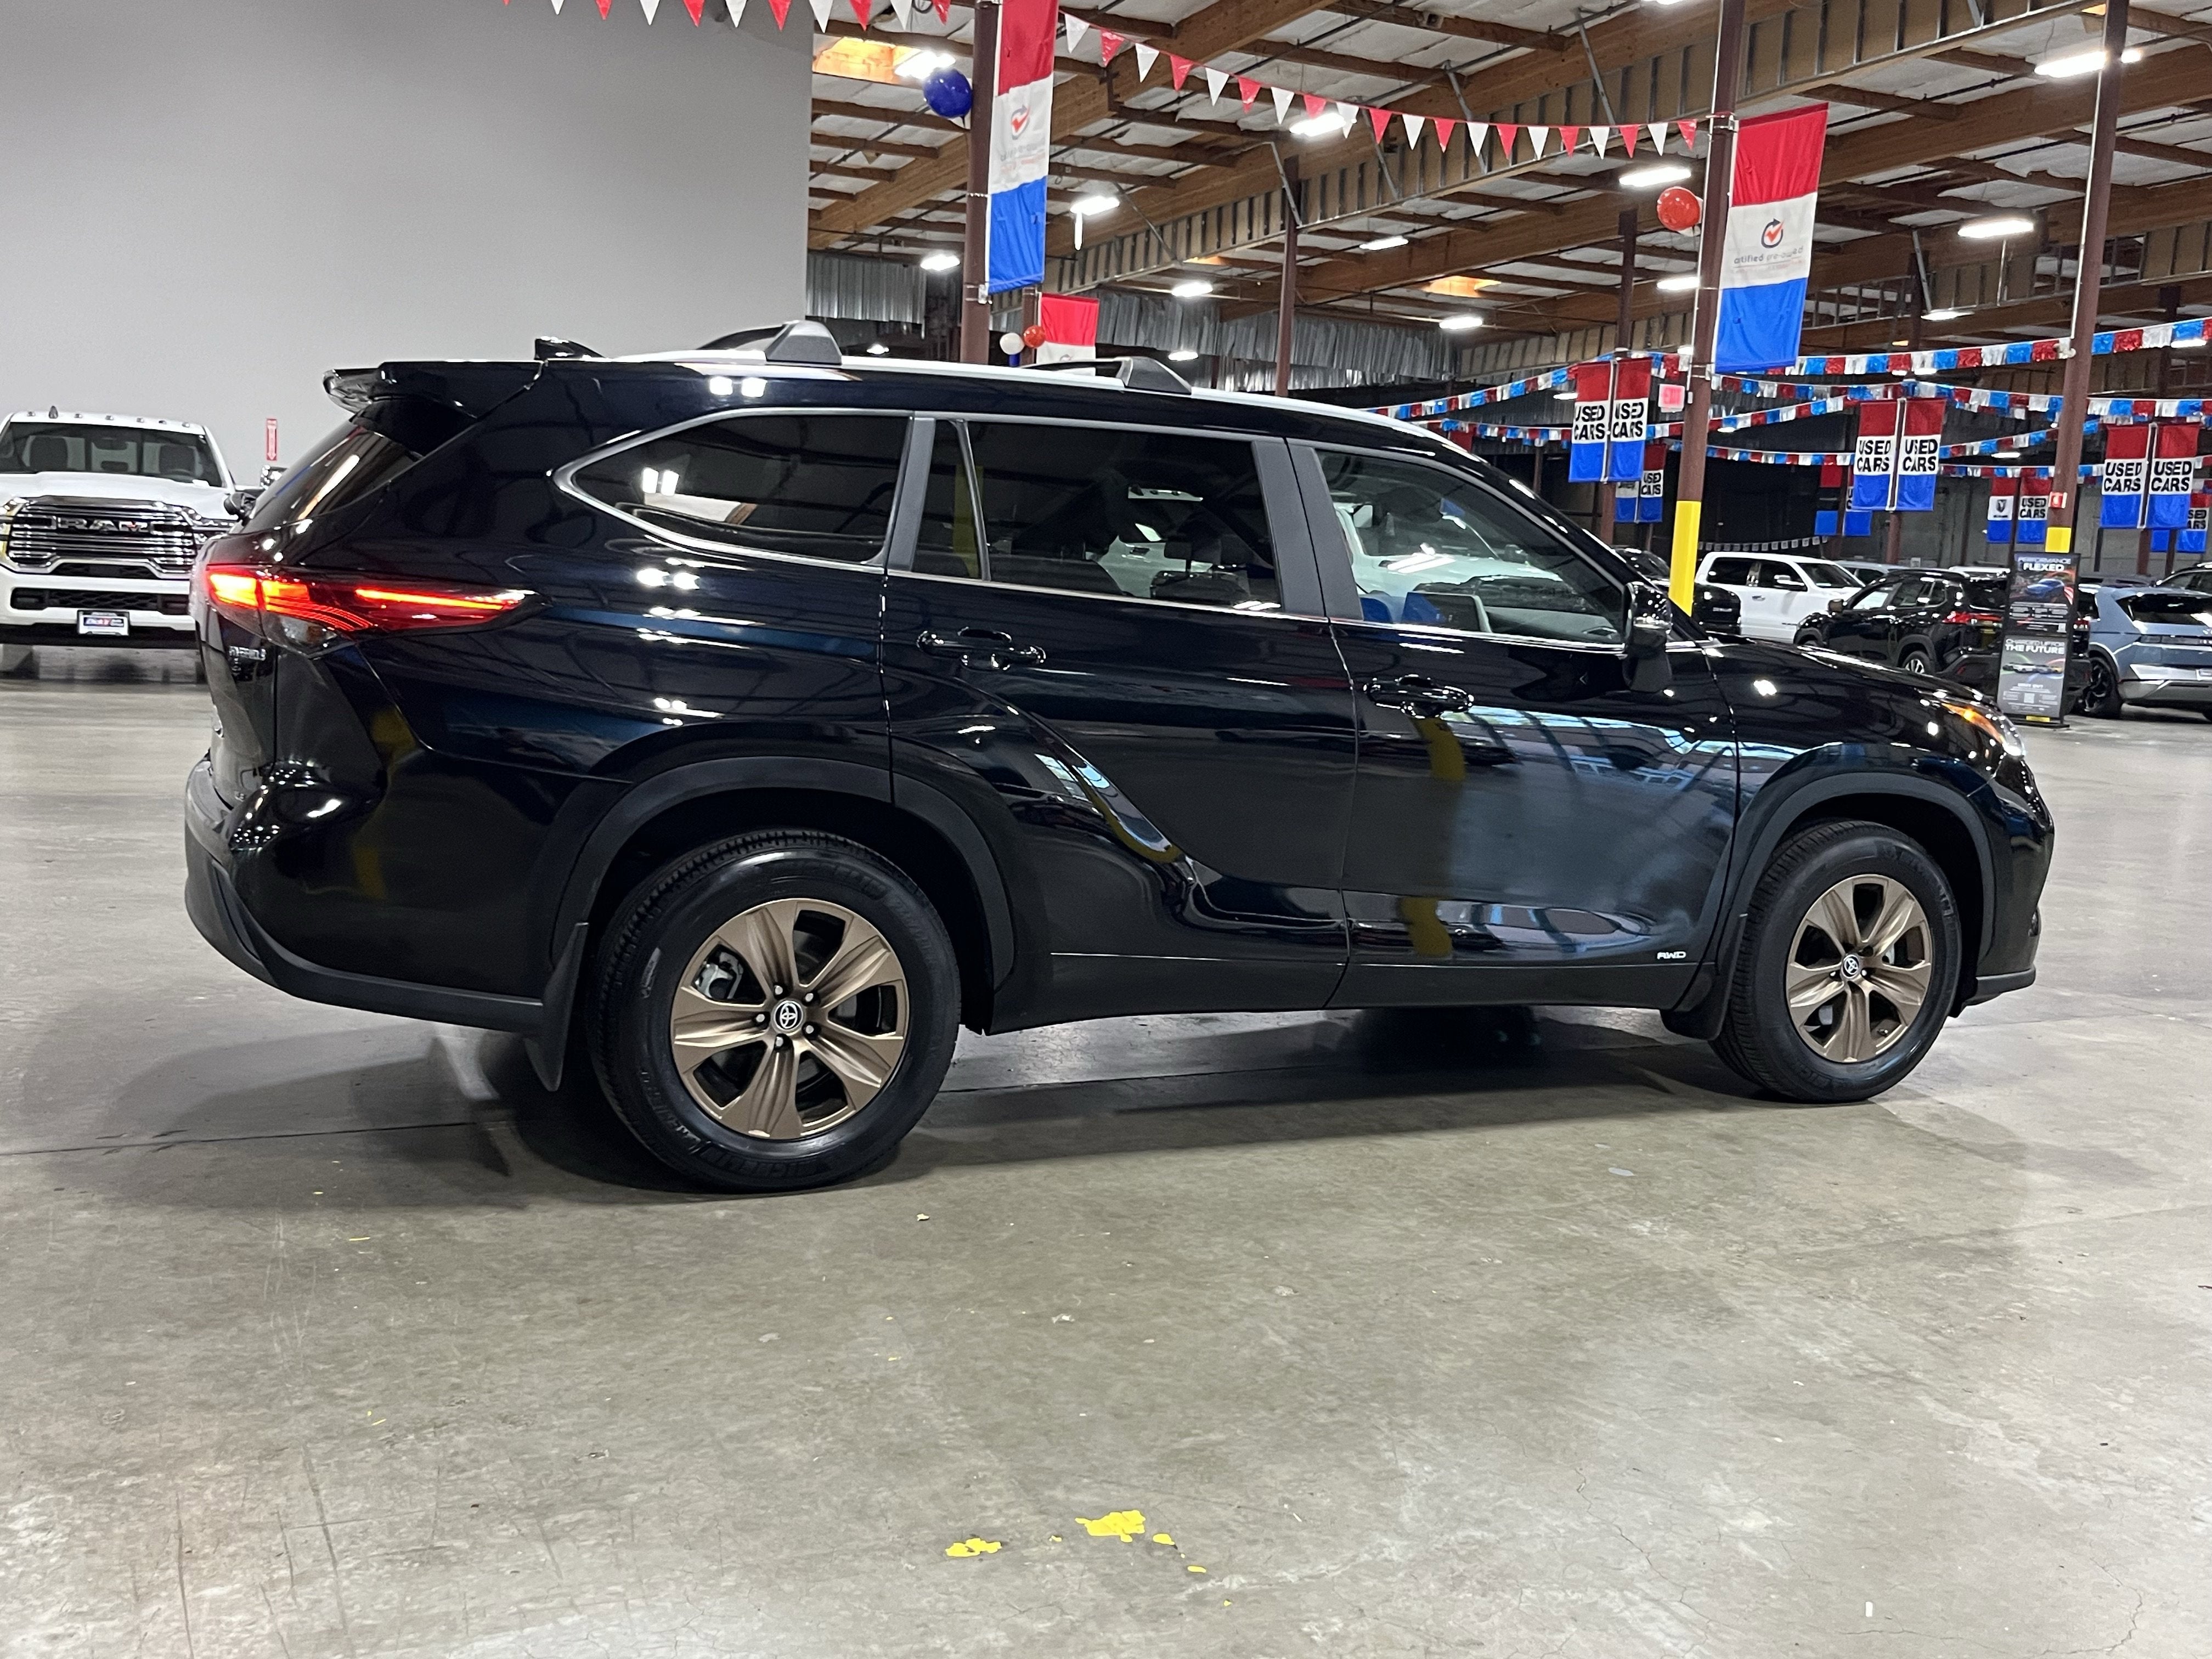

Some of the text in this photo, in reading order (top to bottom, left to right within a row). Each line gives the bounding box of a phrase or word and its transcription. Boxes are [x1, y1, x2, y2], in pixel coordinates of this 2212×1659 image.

[1575, 405, 1605, 422] USED
[1573, 423, 1605, 440] CARS
[1612, 421, 1643, 438] CARS
[1859, 440, 1891, 455] USED
[1905, 439, 1938, 455] USED
[1857, 457, 1890, 472] CARS
[1903, 456, 1937, 472] CARS
[2105, 462, 2142, 477] USED
[2154, 461, 2192, 476] USED
[2103, 478, 2141, 492] CARS
[2151, 477, 2190, 492] CARS
[2022, 498, 2047, 507] USED
[2020, 509, 2046, 518] CARS
[2187, 510, 2207, 519] SED
[58, 517, 149, 533] RAM
[2187, 520, 2207, 529] ARS
[2023, 562, 2064, 571] FLEXED
[2005, 644, 2064, 654] THE FUTURE
